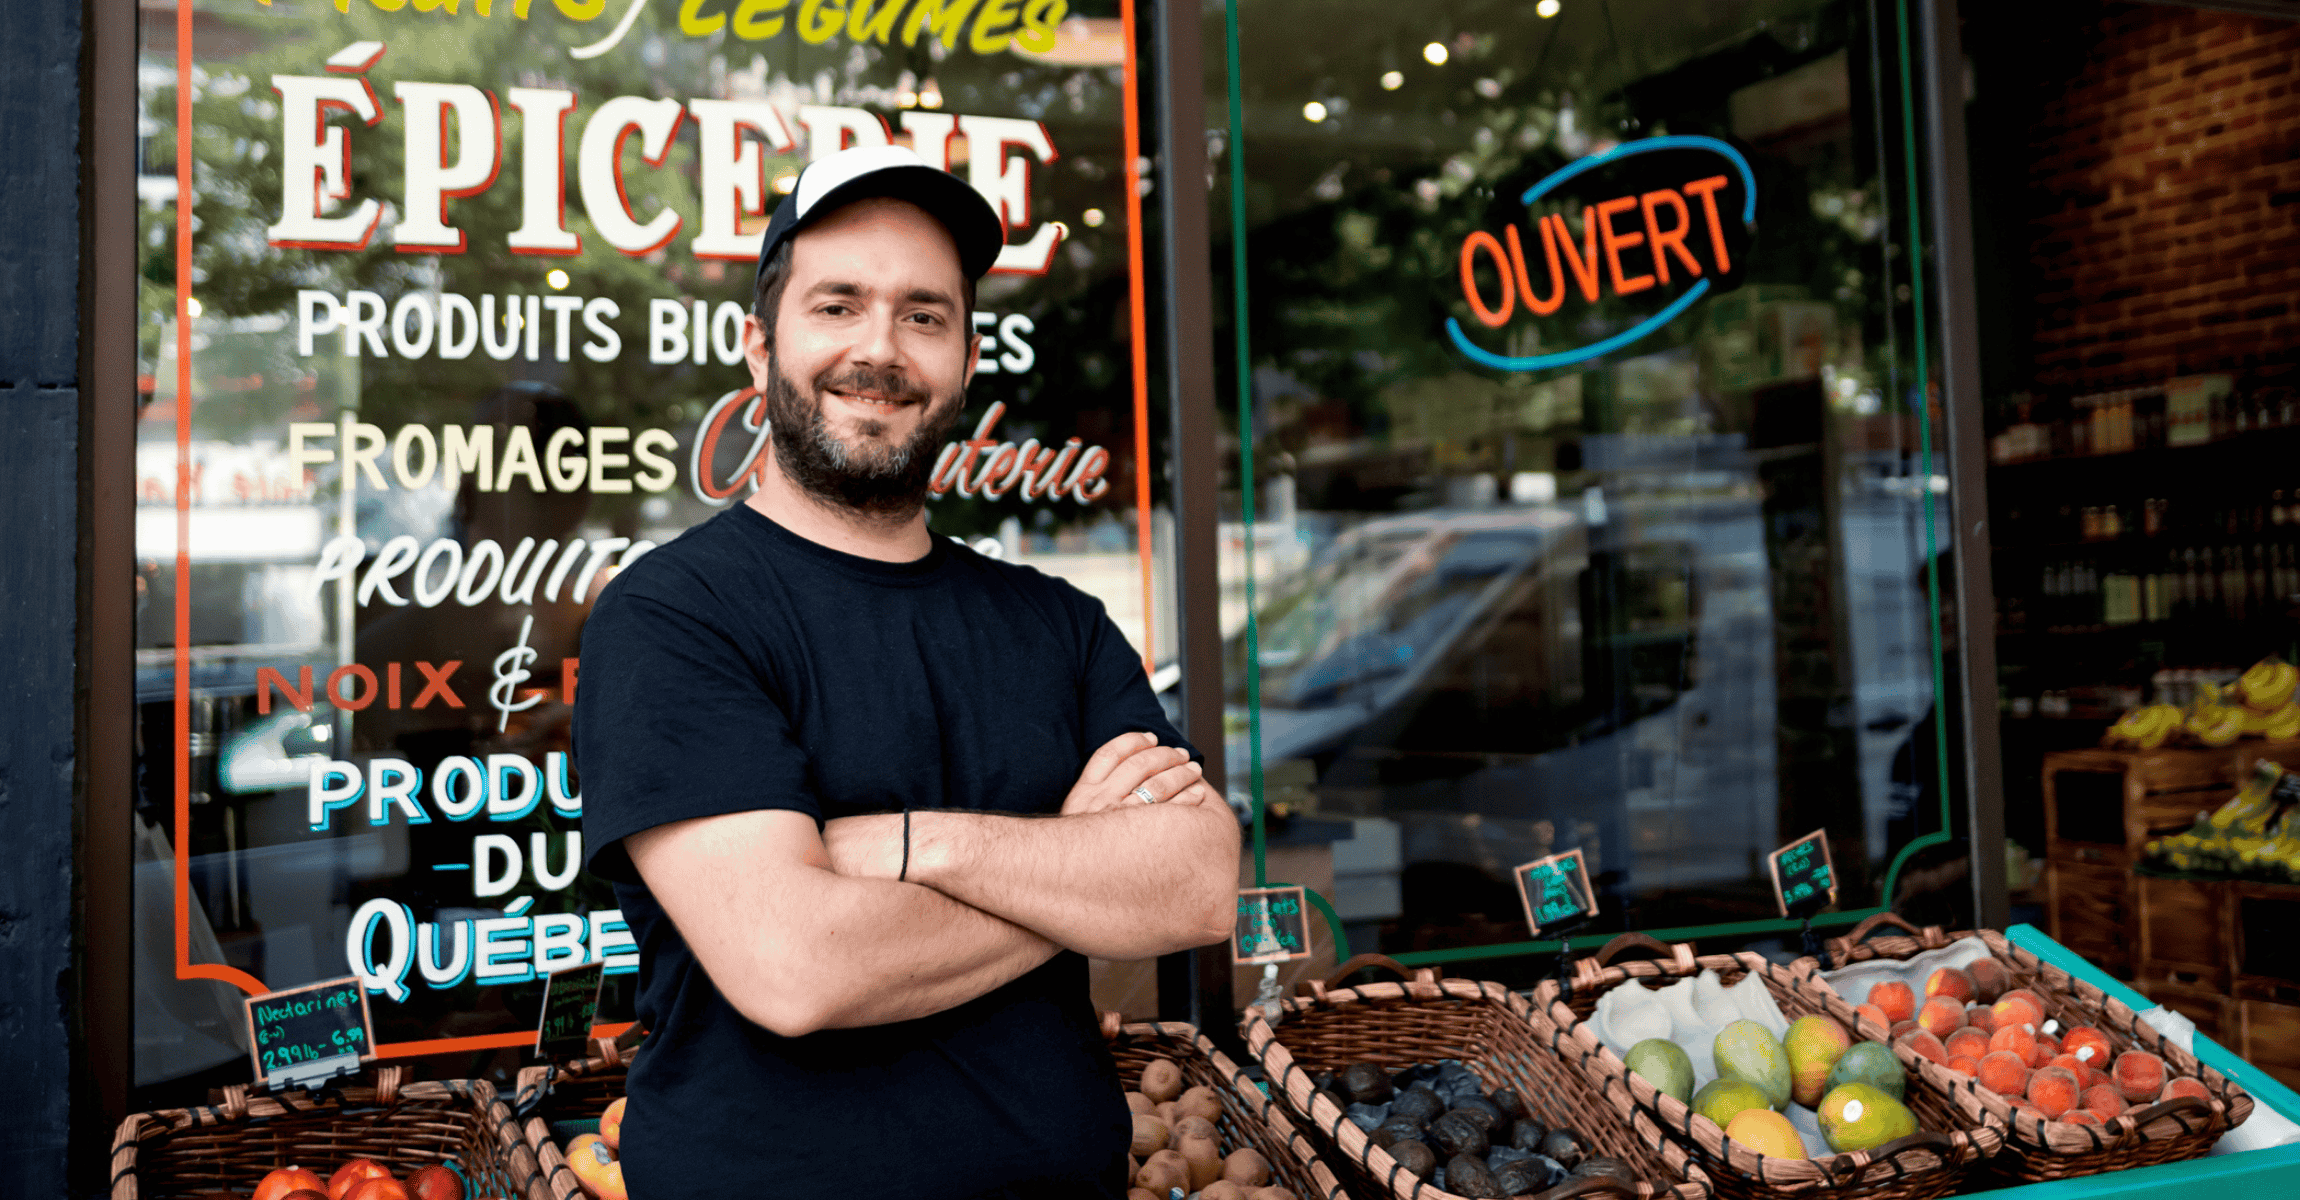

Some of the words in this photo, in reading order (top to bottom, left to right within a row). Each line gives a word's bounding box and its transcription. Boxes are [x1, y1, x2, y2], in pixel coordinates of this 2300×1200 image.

[1459, 174, 1731, 327] OUVERT
[298, 290, 622, 362] PRODUITS
[290, 423, 679, 494] FROMAGES
[256, 660, 466, 715] NOIX
[489, 614, 543, 734] &
[474, 831, 582, 898] DU
[346, 896, 640, 1003] QUÉBE
[257, 989, 359, 1026] Nectarines
[262, 1043, 320, 1070] 2.99lb
